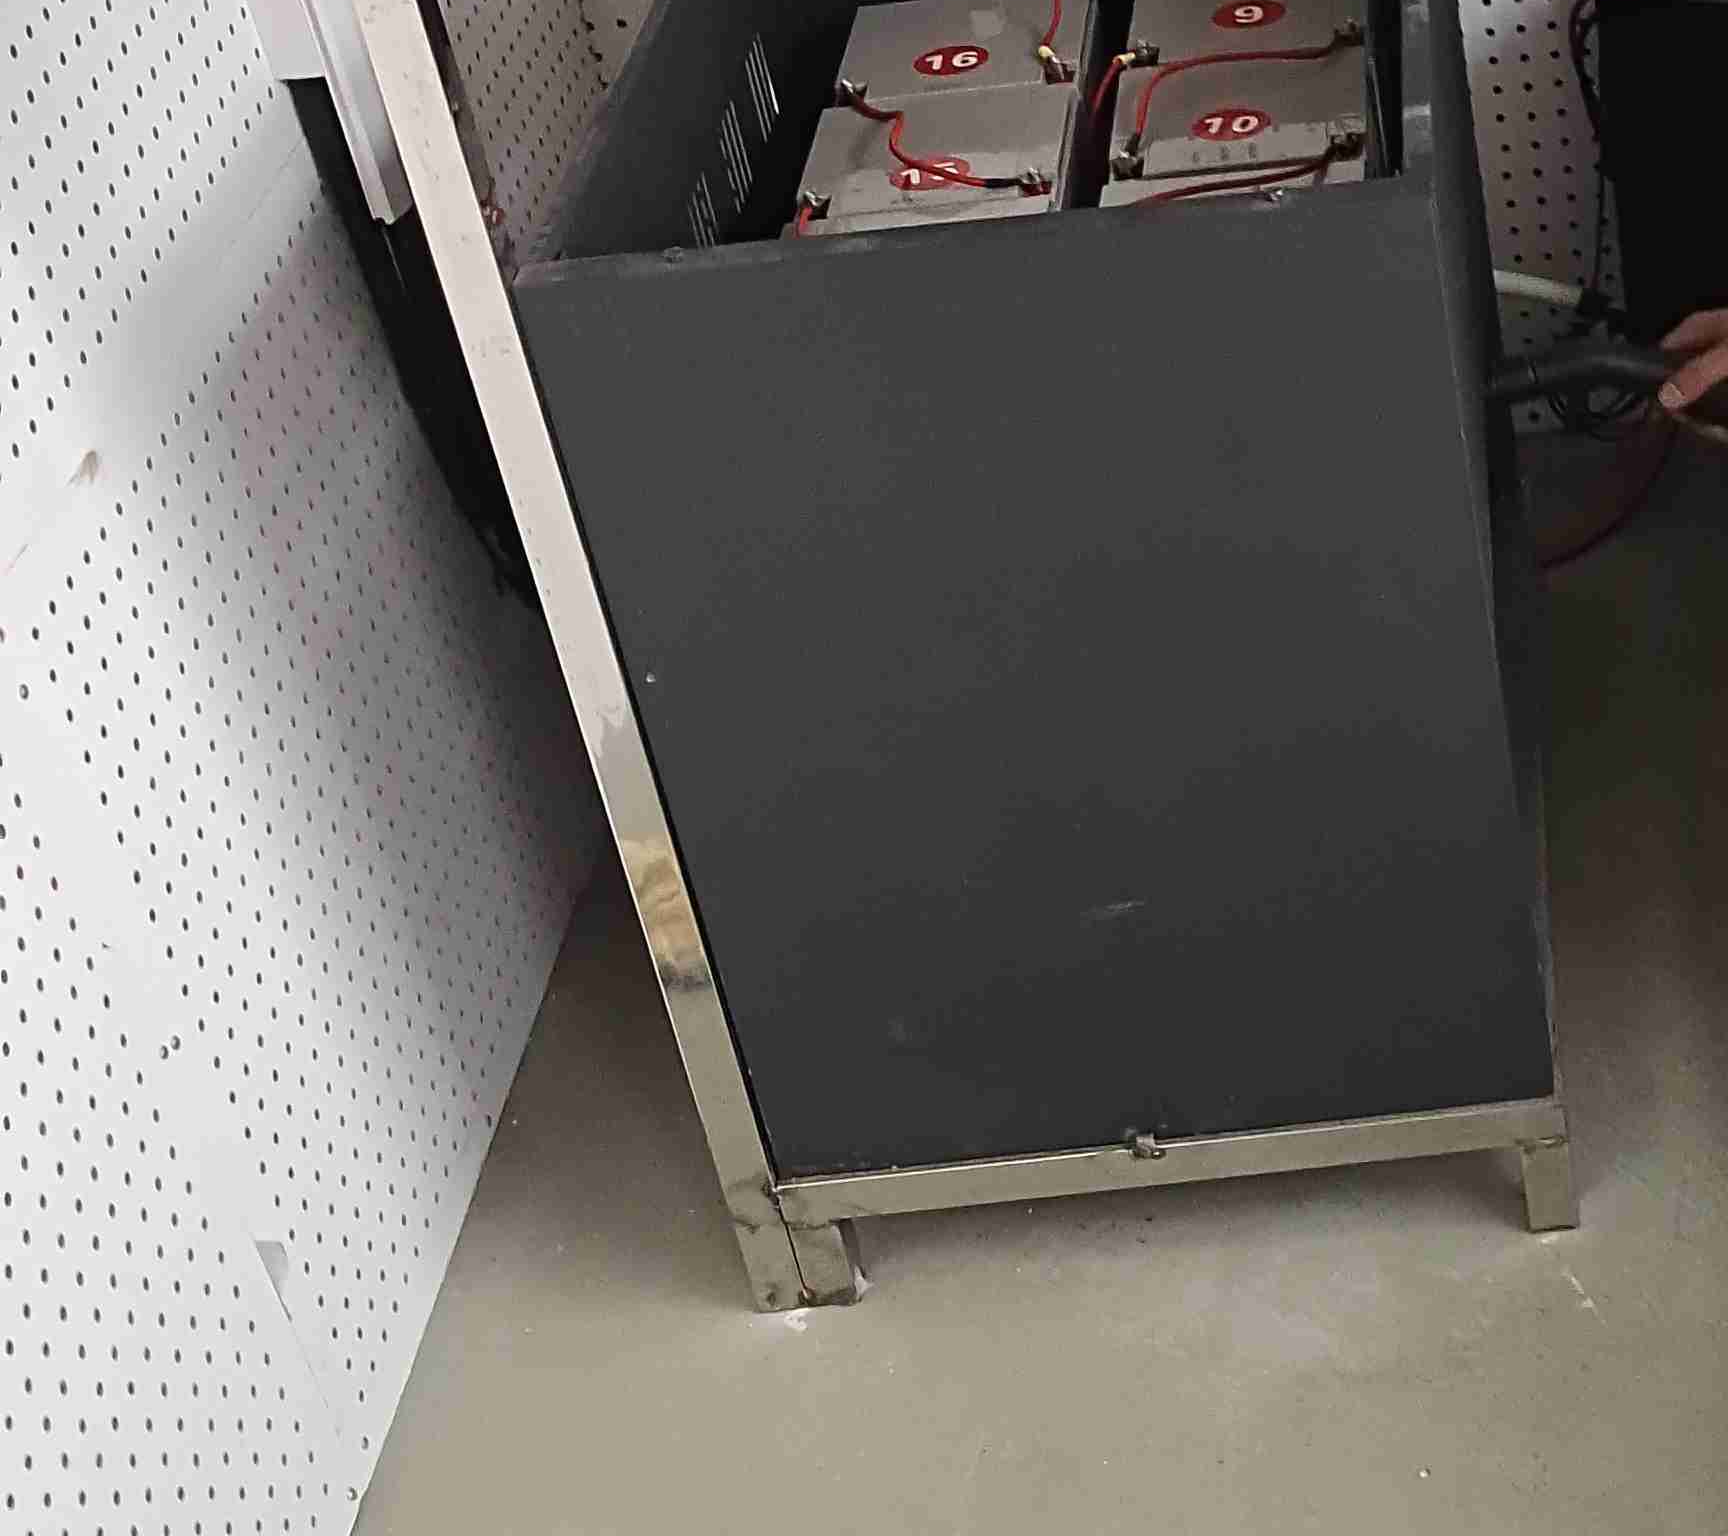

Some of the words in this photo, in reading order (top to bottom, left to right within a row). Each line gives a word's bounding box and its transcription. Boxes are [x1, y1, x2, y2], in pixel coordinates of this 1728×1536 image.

[1234, 5, 1263, 23] 9
[925, 51, 979, 70] 16
[1204, 115, 1259, 134] 10
